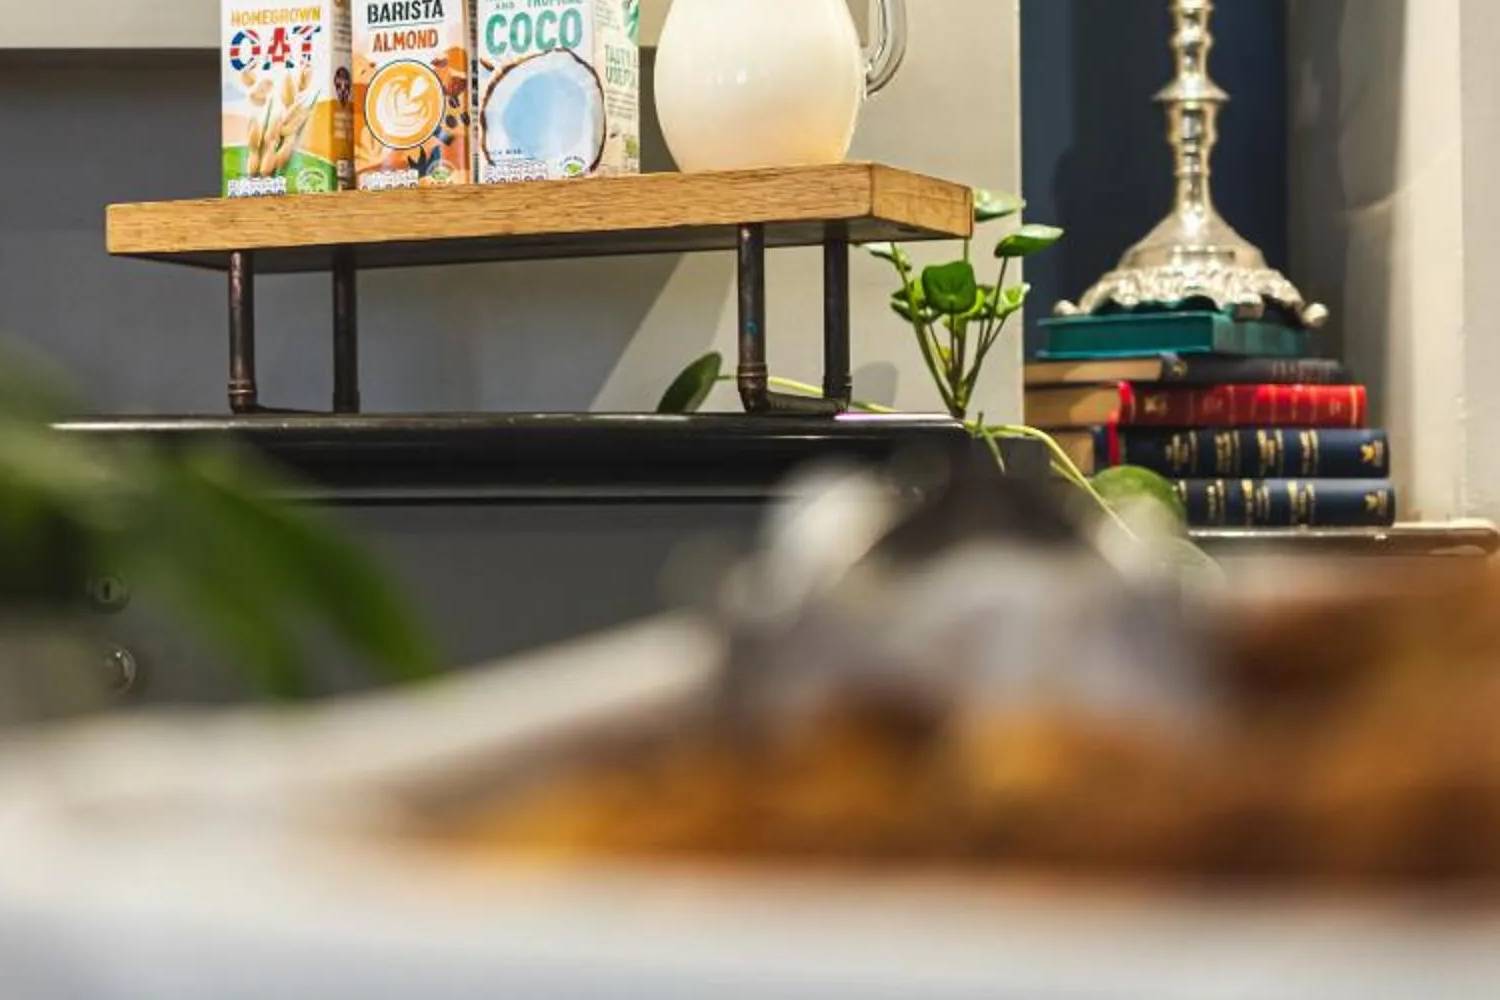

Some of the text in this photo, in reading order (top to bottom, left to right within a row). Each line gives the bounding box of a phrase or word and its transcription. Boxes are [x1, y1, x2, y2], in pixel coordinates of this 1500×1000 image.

[231, 6, 321, 27] HOMEGROWN
[485, 7, 583, 56] COCO
[229, 24, 322, 72] OAT
[372, 28, 439, 52] ALMOND
